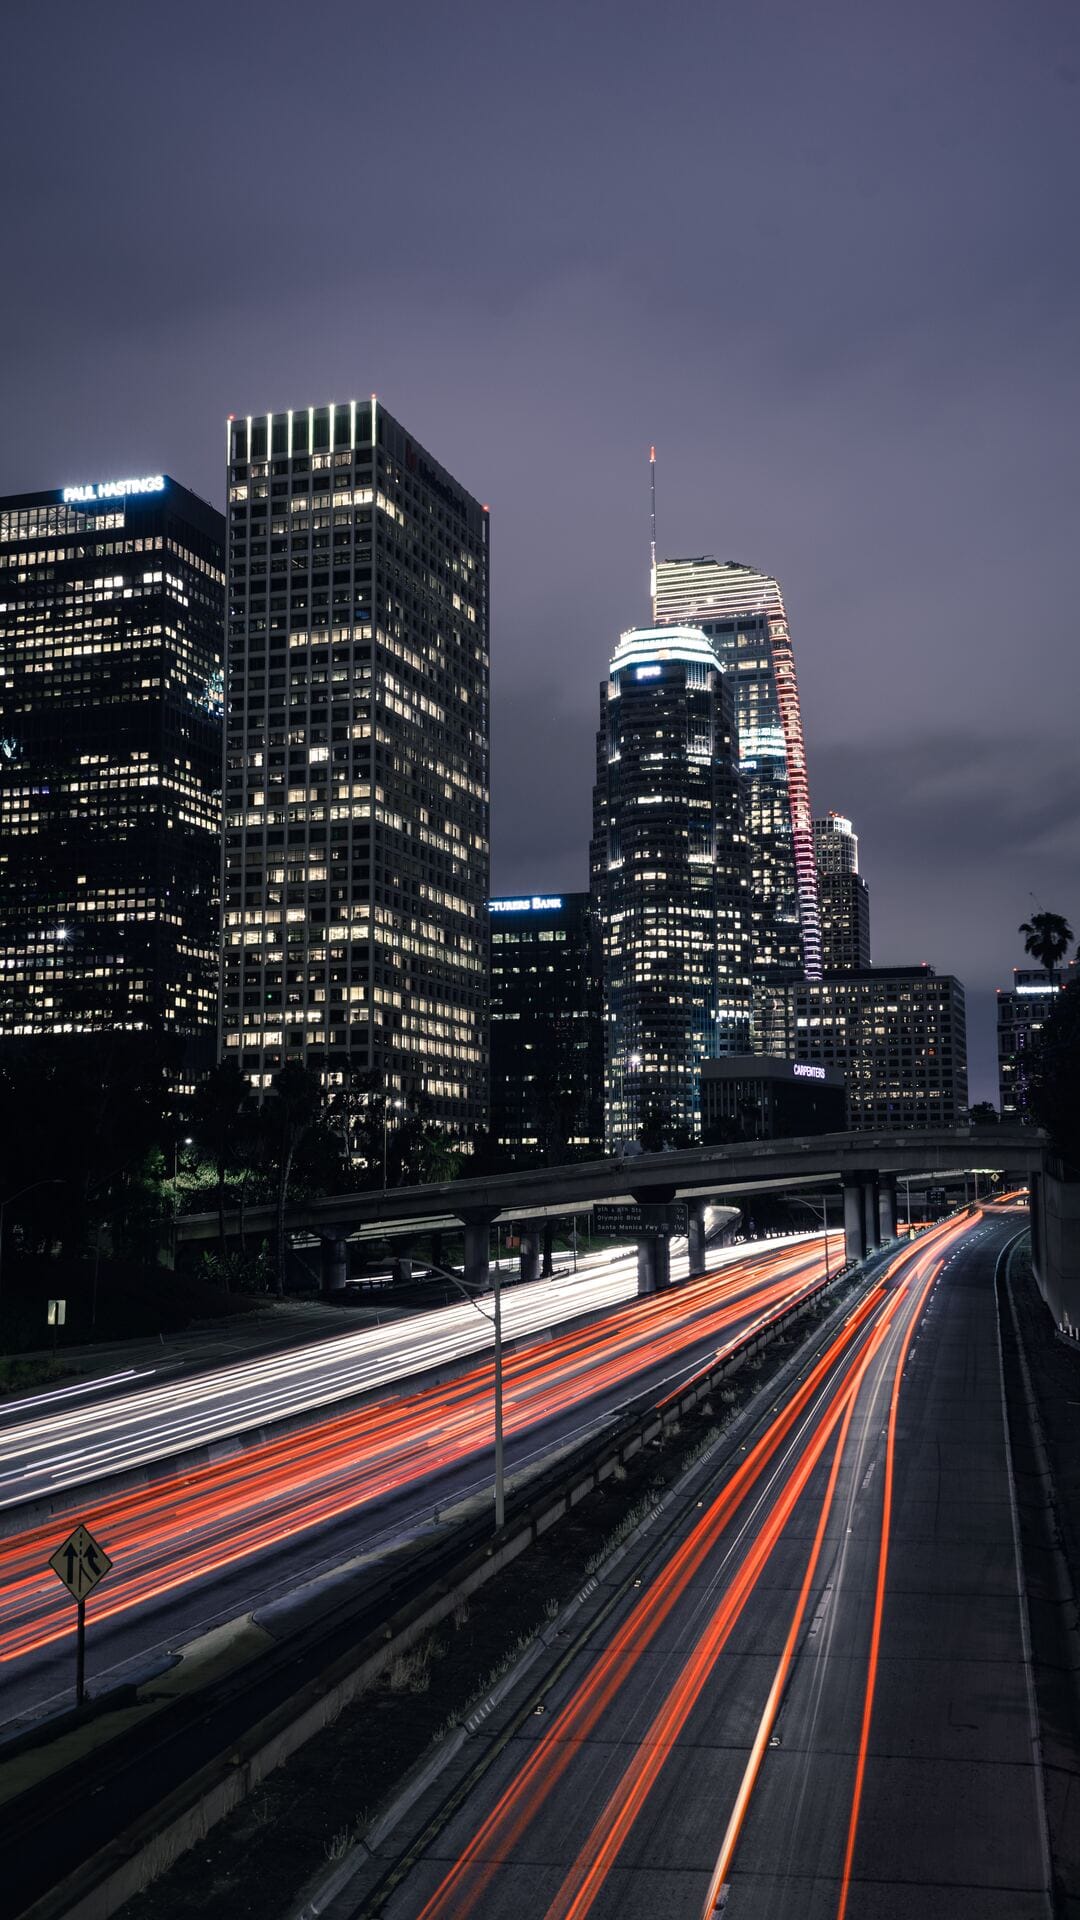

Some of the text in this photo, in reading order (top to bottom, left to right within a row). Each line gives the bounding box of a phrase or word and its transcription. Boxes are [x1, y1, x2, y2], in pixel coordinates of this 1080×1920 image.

[64, 475, 165, 503] PAUL HASTINGS
[793, 1064, 826, 1079] CARPENTERS
